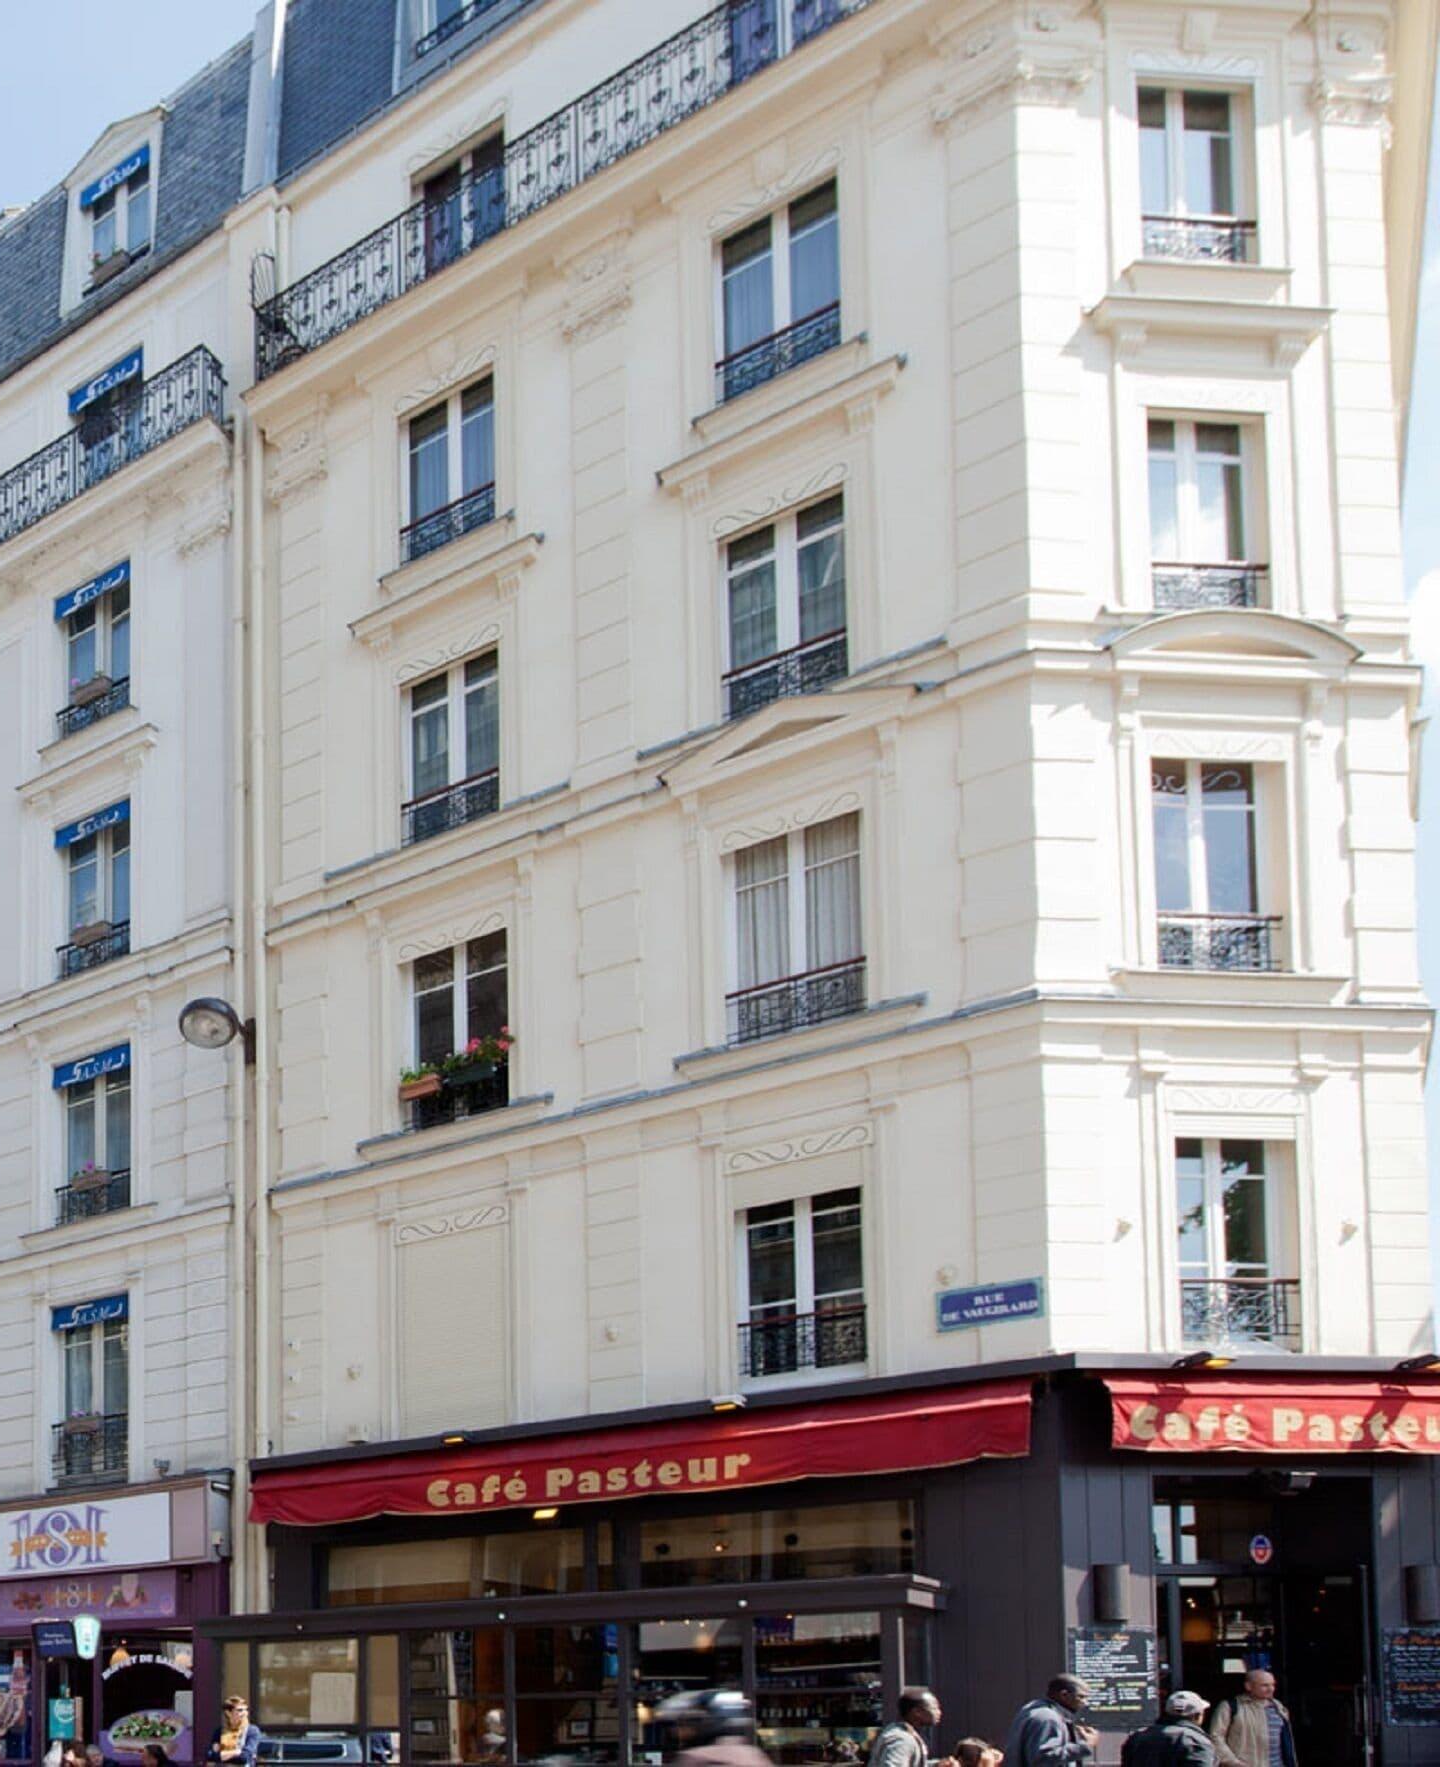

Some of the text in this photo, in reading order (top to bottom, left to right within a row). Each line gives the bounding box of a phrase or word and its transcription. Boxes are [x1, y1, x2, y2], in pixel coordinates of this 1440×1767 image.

[942, 1311, 960, 1322] DE
[973, 1292, 1005, 1306] RUE
[1129, 1403, 1251, 1442] Café
[426, 1453, 752, 1507] Café Pasteur
[9, 1504, 110, 1571] 181
